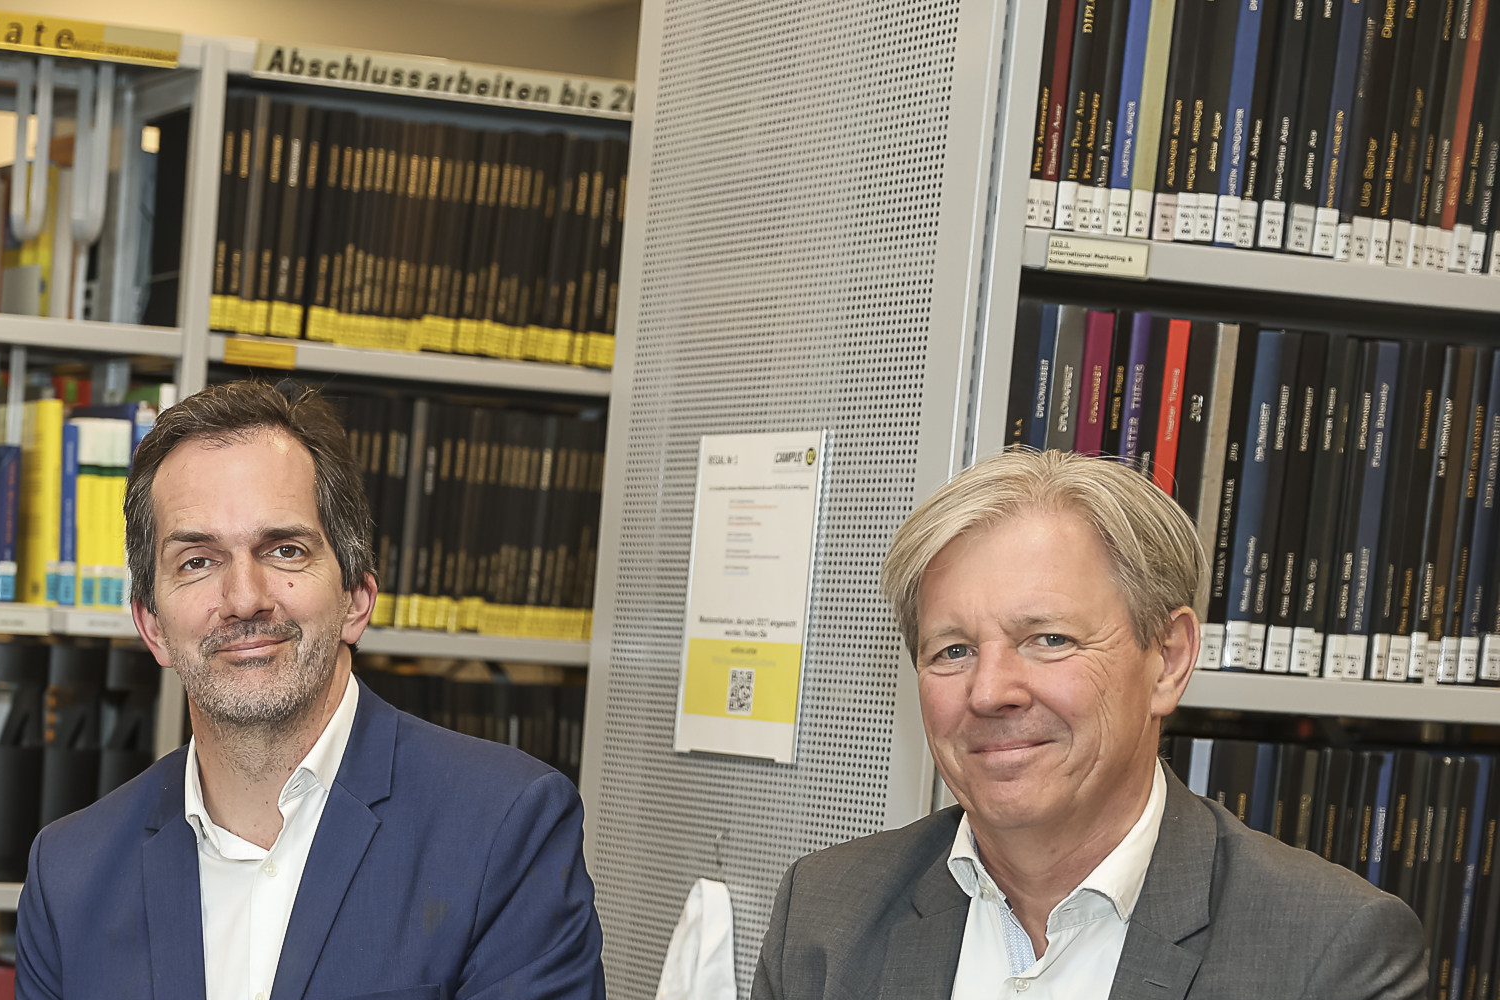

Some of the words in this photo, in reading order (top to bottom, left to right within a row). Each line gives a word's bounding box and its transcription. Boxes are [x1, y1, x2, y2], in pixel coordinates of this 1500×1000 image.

[267, 46, 551, 103] Abschlussarbeiten
[561, 79, 602, 109] bis
[1050, 250, 1092, 259] International
[1094, 253, 1126, 262] Marketing
[1068, 259, 1109, 268] Management
[1035, 359, 1050, 418] DIPLOMARBEIT
[1057, 364, 1074, 432] DIPLOMARBEIT
[1088, 364, 1102, 424] DIPLOMARBEIT
[1113, 365, 1125, 394] THESIS
[1131, 364, 1145, 409] THESIS
[1168, 368, 1180, 402] Thesis
[1110, 396, 1122, 430] MASTER
[1164, 405, 1177, 441] Master
[1189, 394, 1203, 422] 2012
[1273, 384, 1290, 450] MASTERARBEIT
[1299, 386, 1314, 452] MASTERARBEIT
[1357, 392, 1371, 450] DIPLOMARBEIT
[1254, 402, 1270, 462] DIPLOMARBEIT
[1322, 417, 1334, 451] MASTER
[1371, 431, 1383, 467] Florian
[1213, 552, 1226, 598] FLORIAN
[1352, 547, 1370, 631] DIPLOMARBEIT
